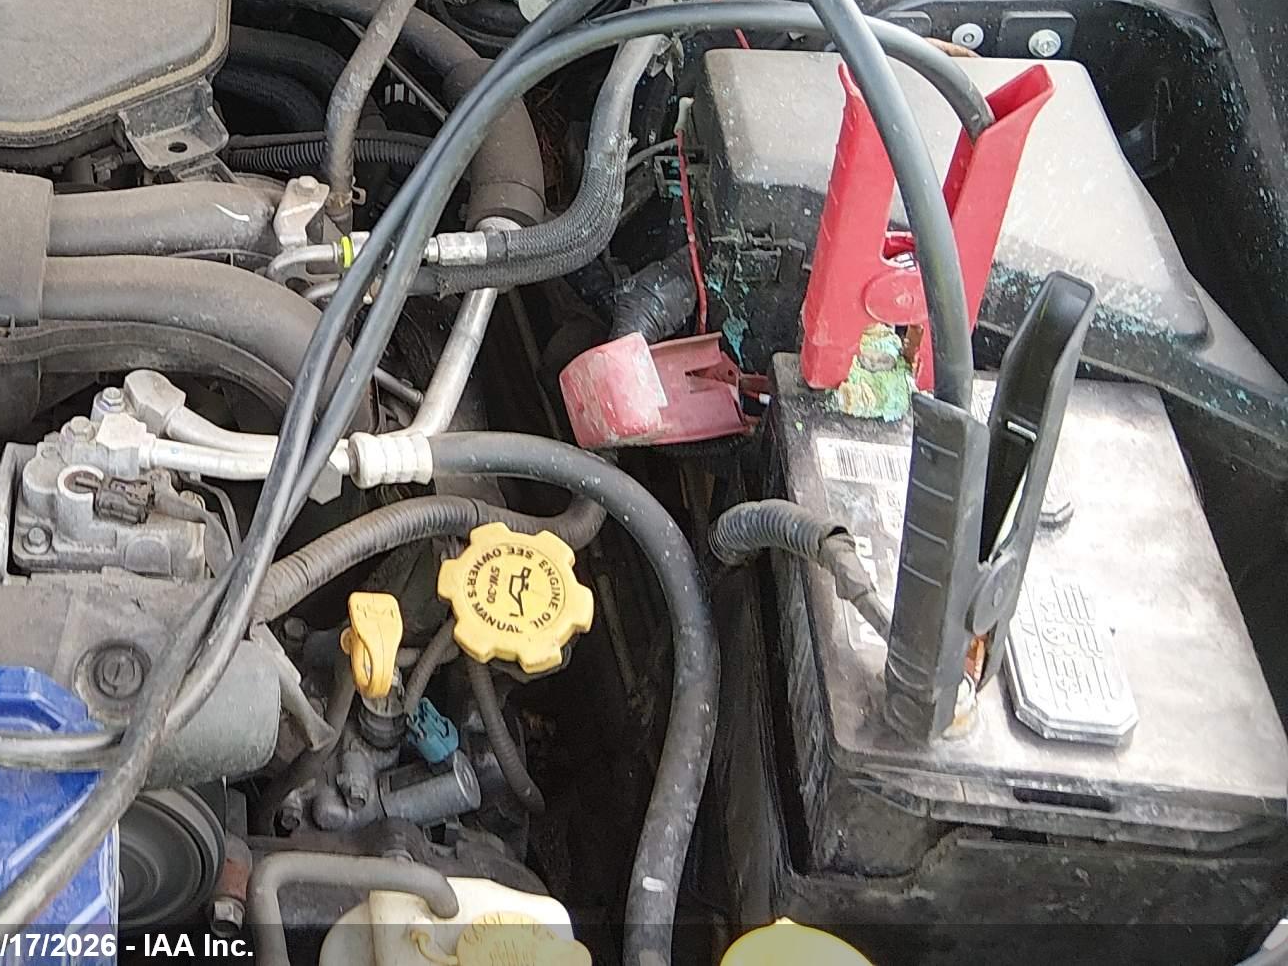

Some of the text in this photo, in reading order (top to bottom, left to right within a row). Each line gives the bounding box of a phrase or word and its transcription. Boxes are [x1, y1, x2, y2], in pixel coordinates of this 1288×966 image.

[506, 546, 535, 559] SEE
[530, 560, 561, 630] ENGINE OIL
[472, 601, 523, 634] MANUAL
